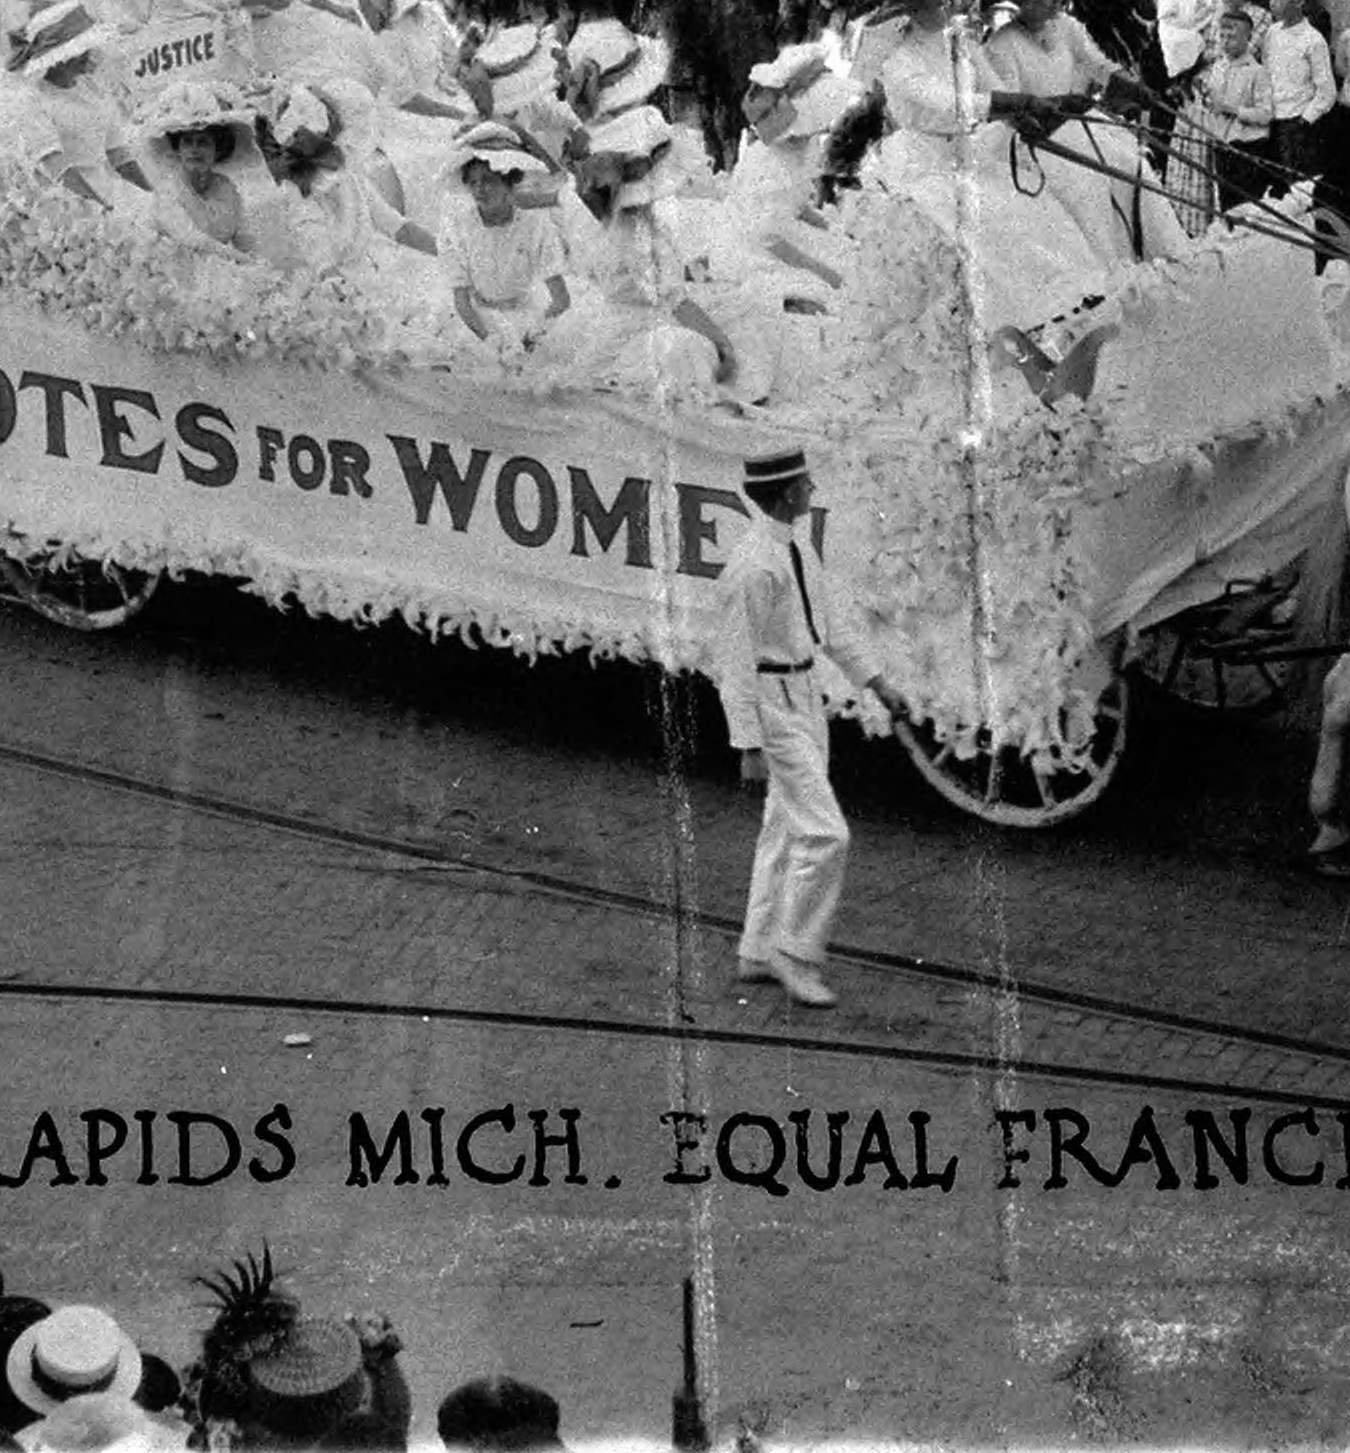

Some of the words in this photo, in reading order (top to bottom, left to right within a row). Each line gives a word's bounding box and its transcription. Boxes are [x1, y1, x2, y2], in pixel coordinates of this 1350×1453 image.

[134, 30, 215, 78] JUSTICE
[254, 424, 374, 498] FOR
[385, 433, 830, 580] WOME
